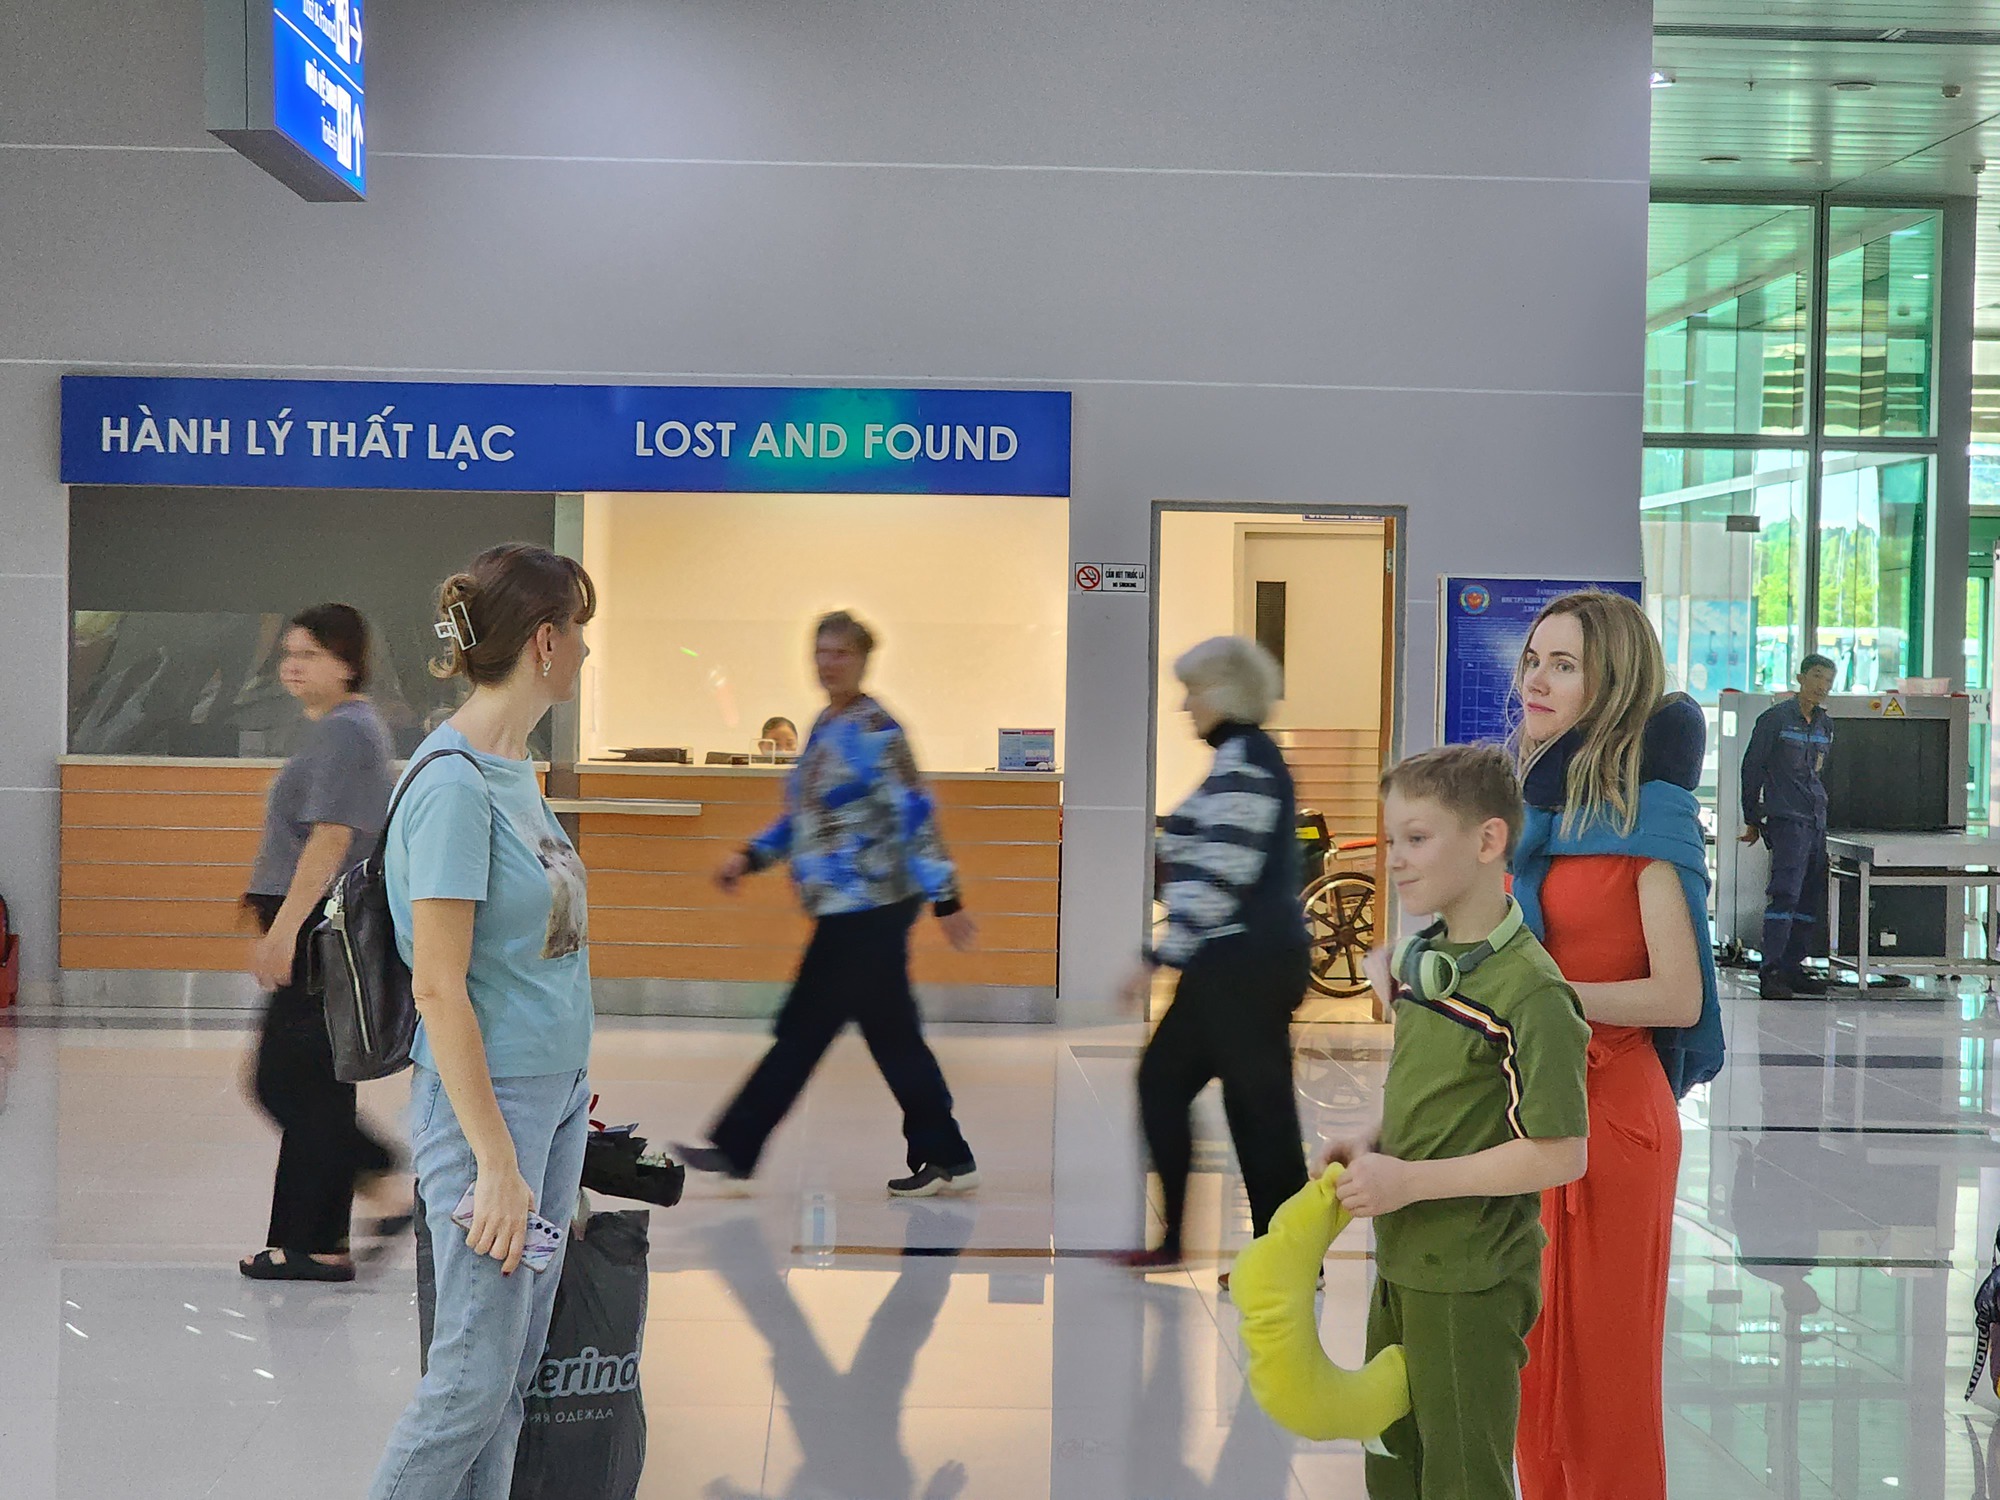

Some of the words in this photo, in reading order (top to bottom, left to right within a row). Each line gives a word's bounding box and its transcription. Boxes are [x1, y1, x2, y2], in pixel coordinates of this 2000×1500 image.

[101, 404, 230, 455] HÀNH
[247, 408, 293, 456] LÝ
[307, 405, 414, 458] THẤT
[428, 424, 516, 471] LẠC
[635, 420, 736, 458] LOST
[749, 422, 848, 459] AND
[864, 423, 1019, 462] FOUND
[1969, 694, 1982, 703] XI
[528, 1349, 639, 1394] erina
[555, 1408, 614, 1424] ОДЕЖДА
